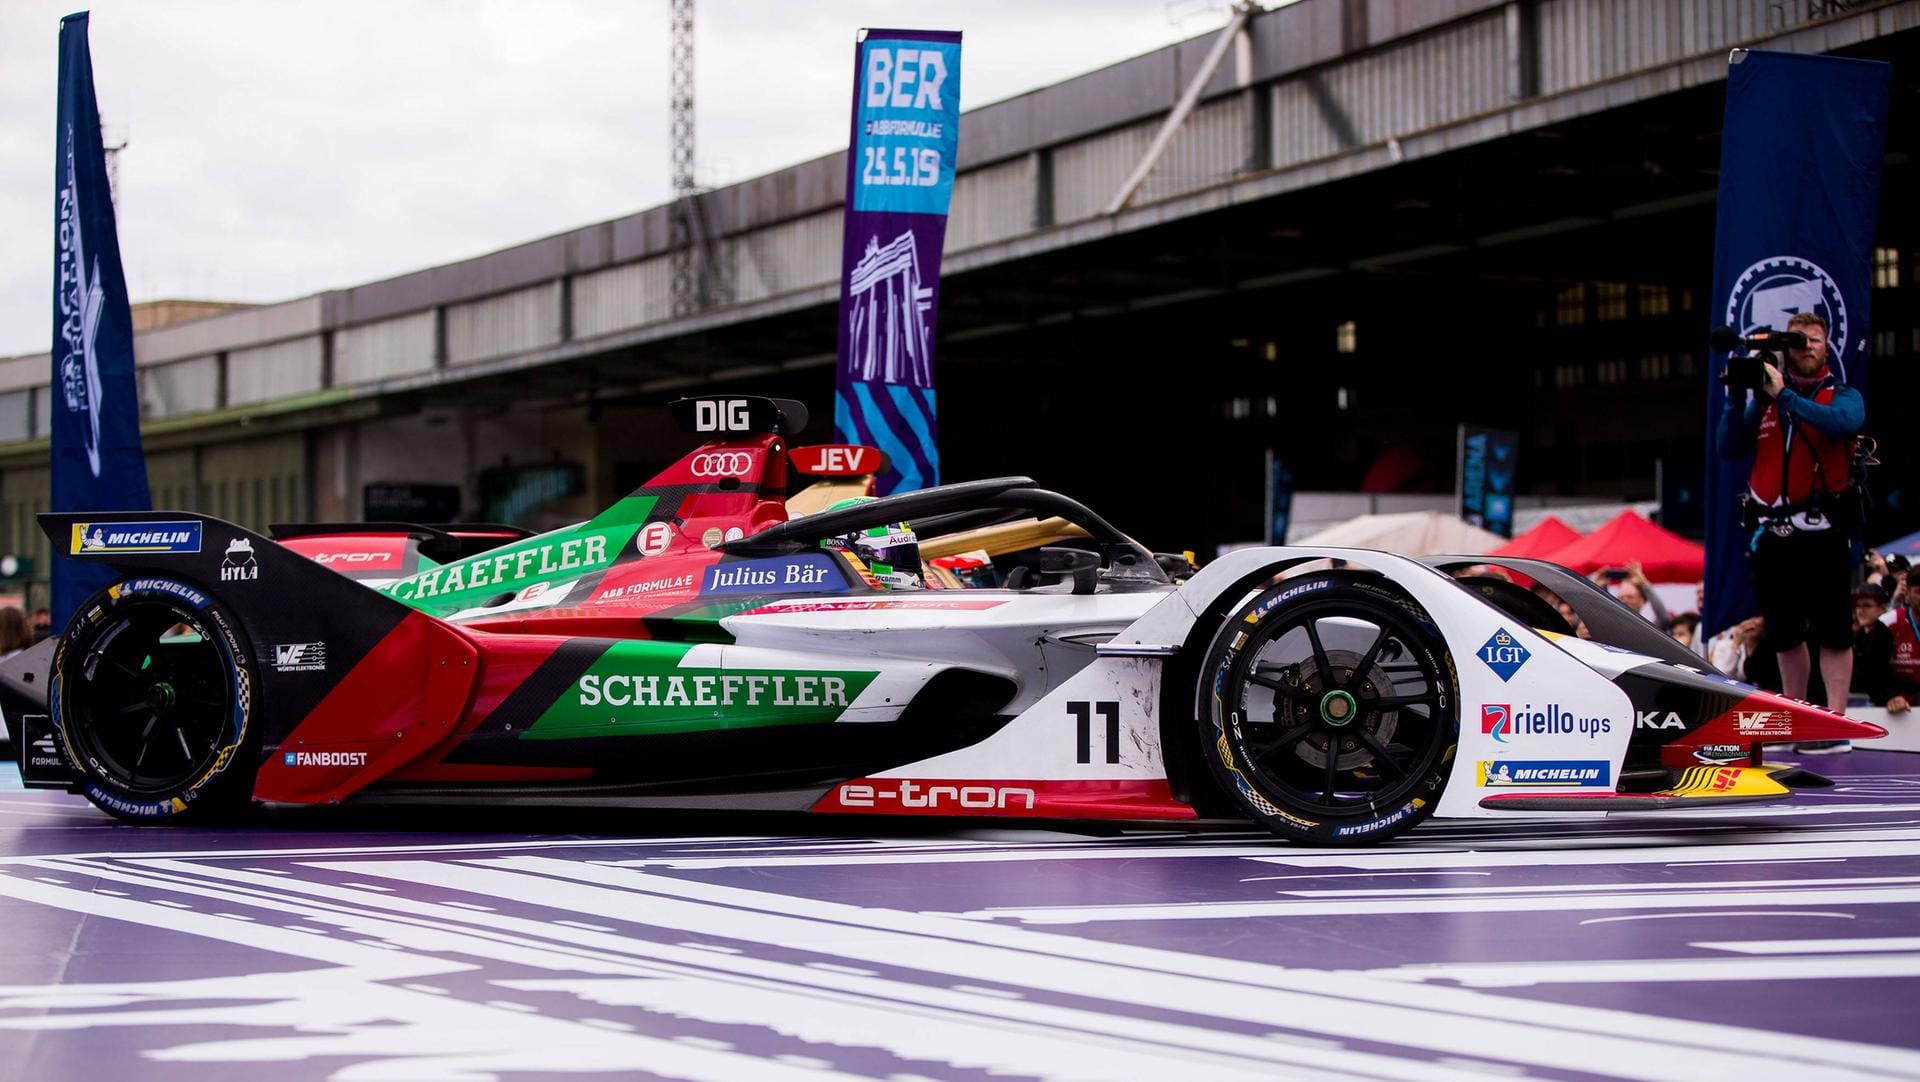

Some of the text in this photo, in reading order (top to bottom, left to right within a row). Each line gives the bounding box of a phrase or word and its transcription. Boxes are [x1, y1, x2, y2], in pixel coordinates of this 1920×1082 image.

[866, 48, 948, 110] BER
[863, 147, 940, 187] 25.5.19
[60, 188, 72, 341] ACTION
[695, 400, 750, 431] DIG
[811, 448, 864, 471] JEV
[107, 531, 191, 545] MICHELIN
[220, 566, 258, 581] HYLA
[710, 564, 828, 590] Julius Bär
[133, 579, 205, 606] MICHELIN
[599, 587, 624, 599] ABB
[1266, 580, 1329, 609] MICHELIN
[1486, 646, 1524, 663] LGT
[580, 675, 849, 706] SCHAEFFLER
[1066, 701, 1120, 764] 11
[1515, 704, 1611, 738] riello ups
[1637, 711, 1686, 729] KA
[284, 752, 367, 766] #FANBOOST
[1514, 768, 1600, 779] MICHELIN
[91, 787, 158, 815] MICHELIN
[839, 780, 1035, 809] e-tron
[1338, 811, 1403, 836] MICHELIN
